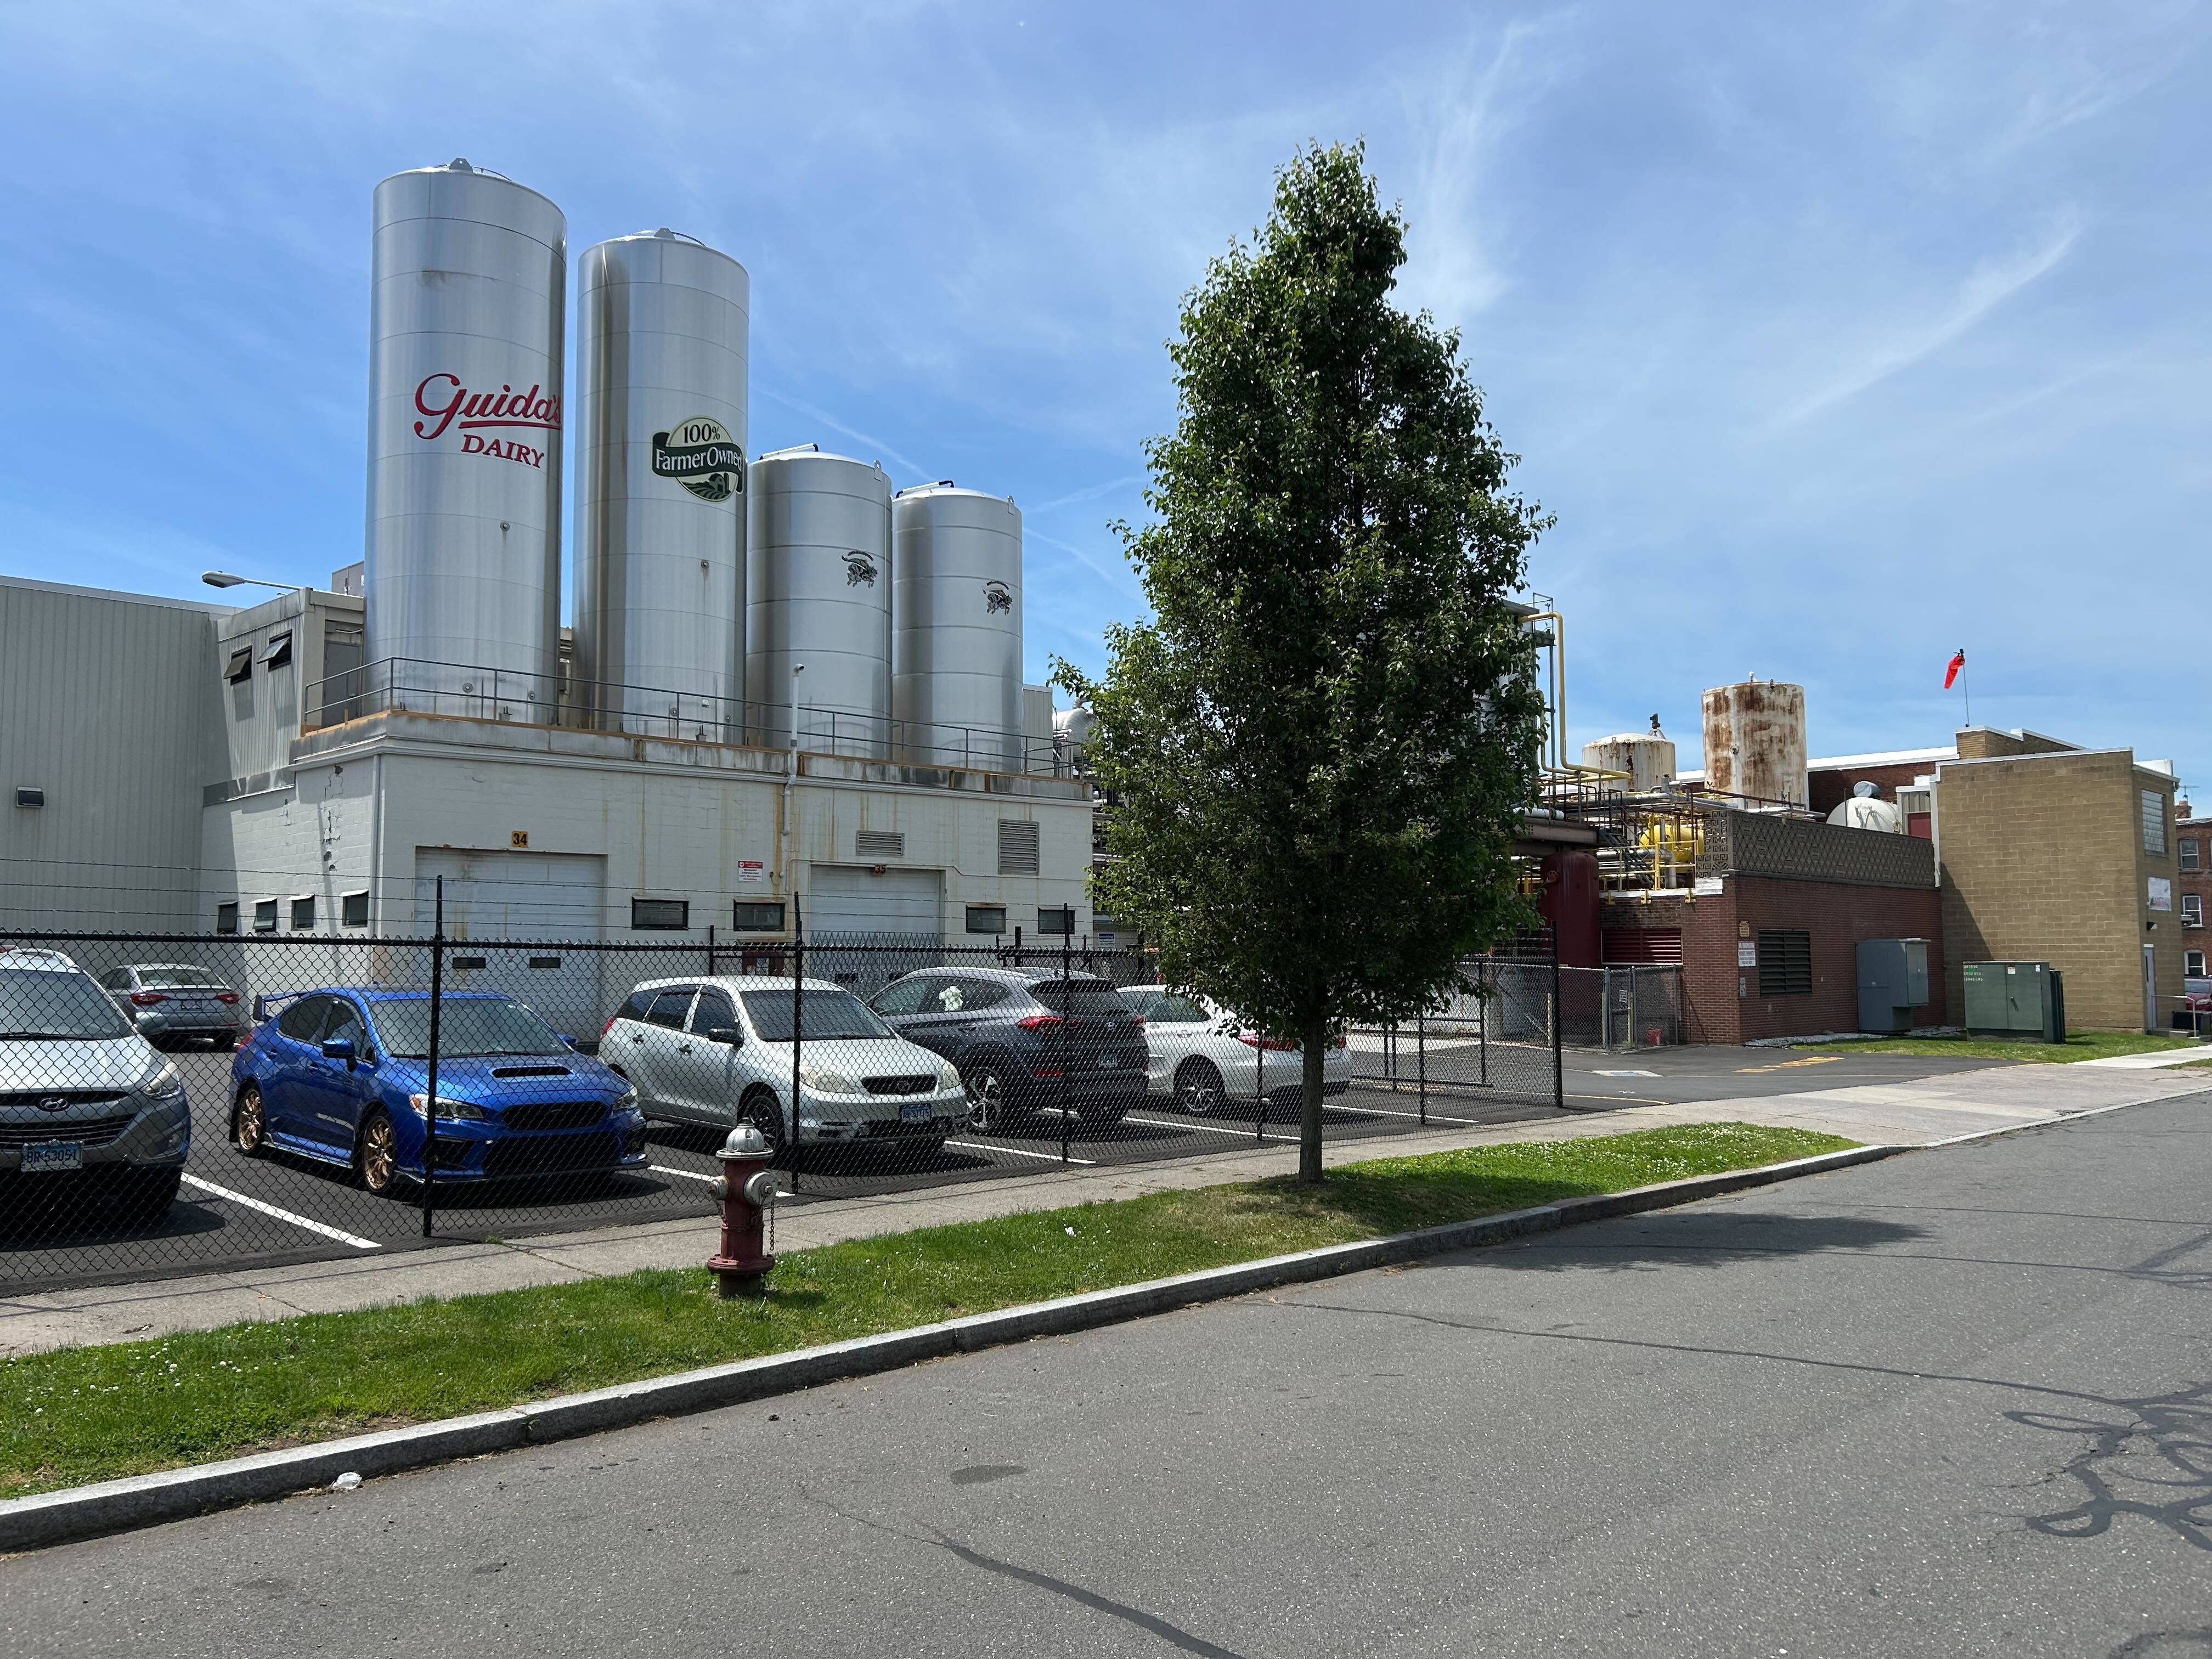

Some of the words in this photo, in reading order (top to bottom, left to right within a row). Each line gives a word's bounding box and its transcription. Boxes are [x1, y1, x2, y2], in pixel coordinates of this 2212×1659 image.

[684, 424, 720, 443] 100%
[461, 434, 544, 468] DAIRY
[656, 448, 707, 471] Farmer
[707, 446, 742, 473] Owned
[513, 833, 527, 845] 34
